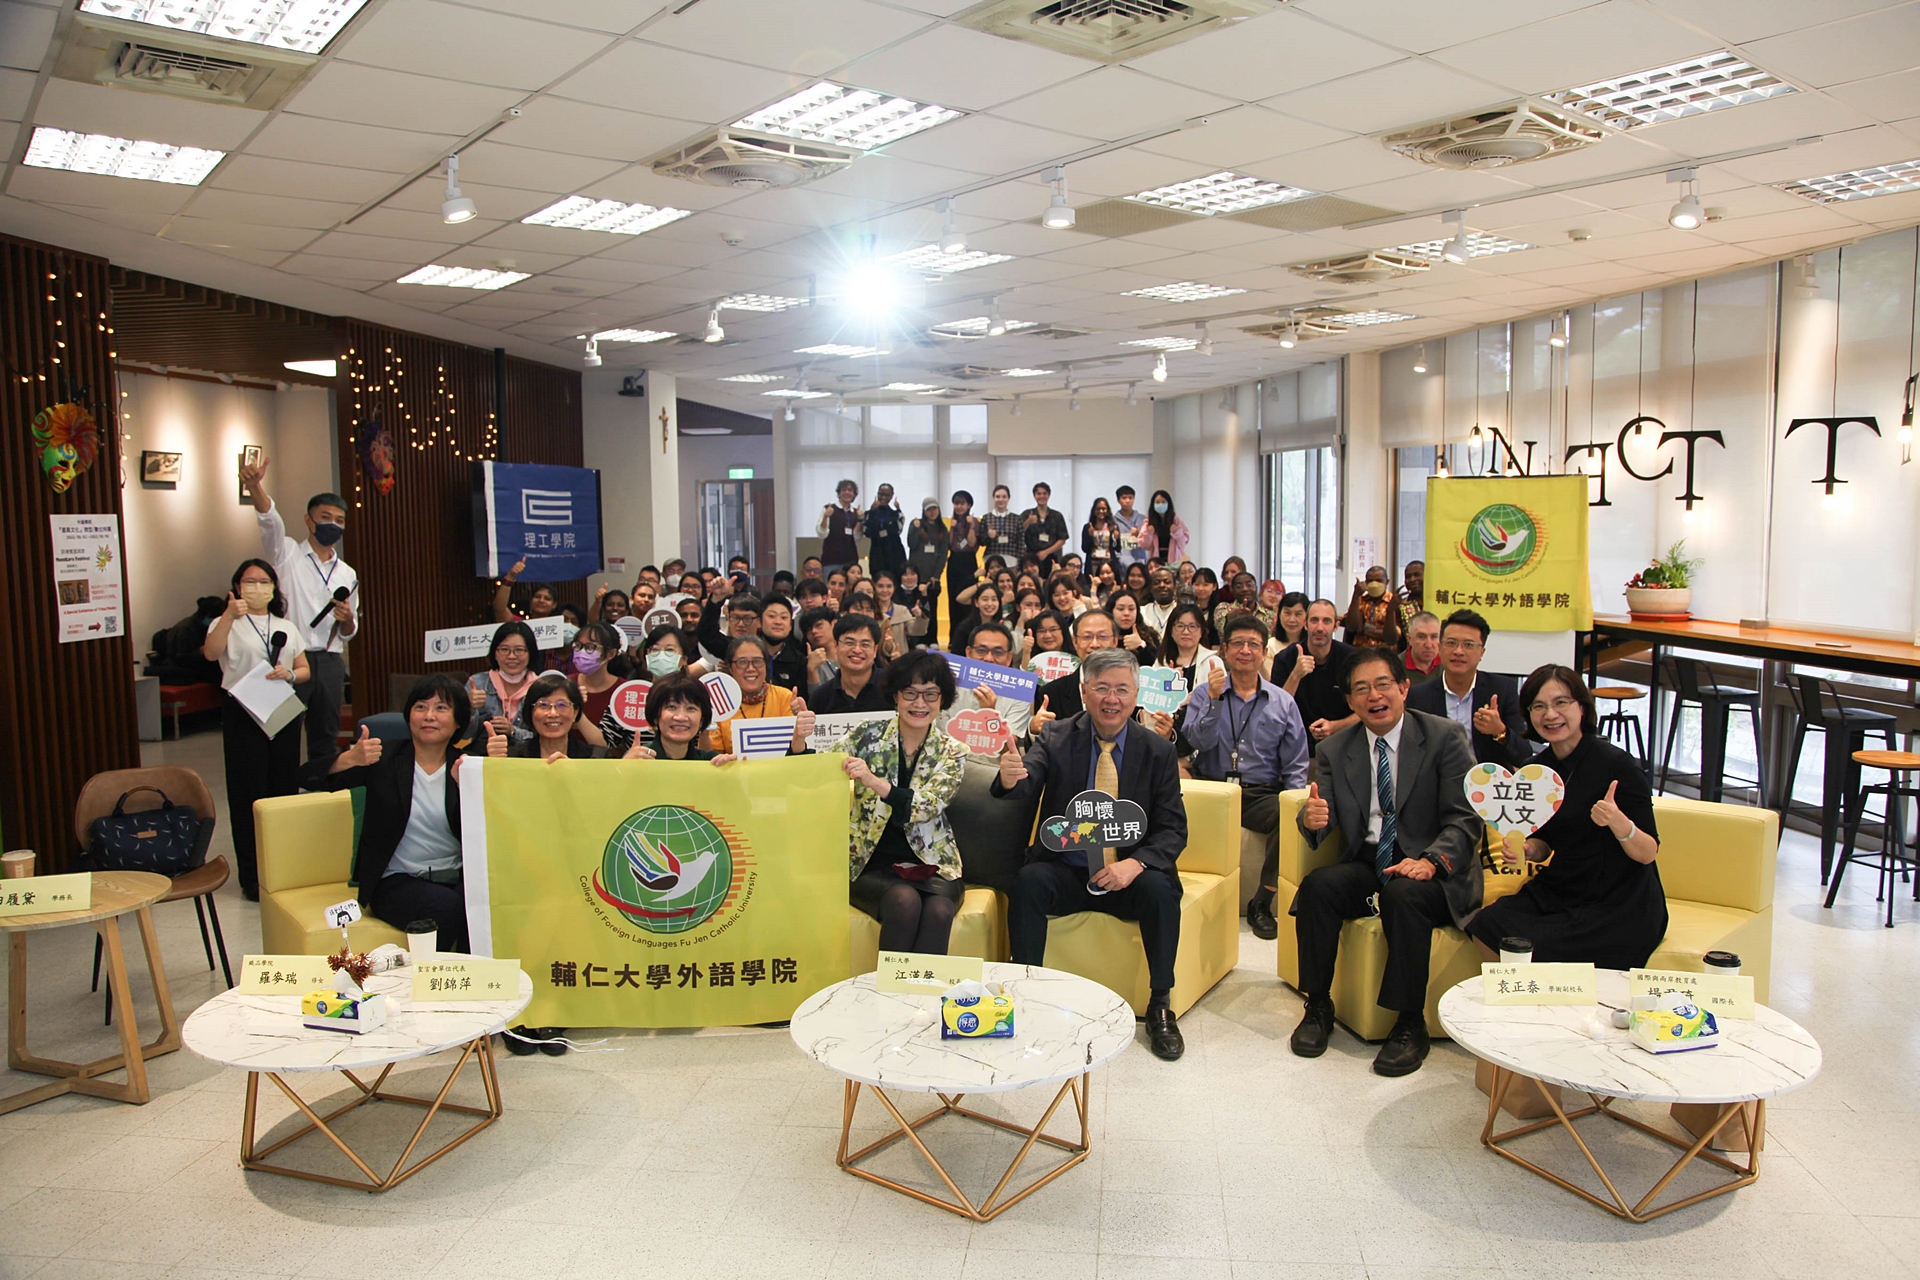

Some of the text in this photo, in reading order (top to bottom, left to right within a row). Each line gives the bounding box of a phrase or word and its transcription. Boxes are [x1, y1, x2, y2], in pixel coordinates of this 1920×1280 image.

[524, 532, 576, 549] 理工學院
[1435, 588, 1571, 609] 輔仁大學外語學院
[650, 614, 670, 626] 理工
[1047, 656, 1071, 669] 輔仁
[969, 666, 1034, 689] 輔仁大學理工學院
[1140, 674, 1161, 690] 理工
[625, 691, 649, 705] 理工
[958, 718, 983, 732] 理工
[1493, 782, 1535, 801] 立足
[1074, 800, 1115, 820] 胸懷
[1494, 805, 1536, 825] 人文
[1102, 821, 1142, 842] 世界
[579, 870, 758, 950] College of Foreign Languages Fu Jen Catholic University
[884, 956, 910, 964] 輔仁大學
[550, 957, 799, 991] 輔仁大學外語學院
[1489, 968, 1518, 976] 輔仁大學
[1637, 974, 1698, 985] 國際與兩岸教育處
[429, 976, 472, 991] 劉錦萍
[1497, 979, 1540, 994] 袁正泰
[1712, 997, 1735, 1006] 國際長
